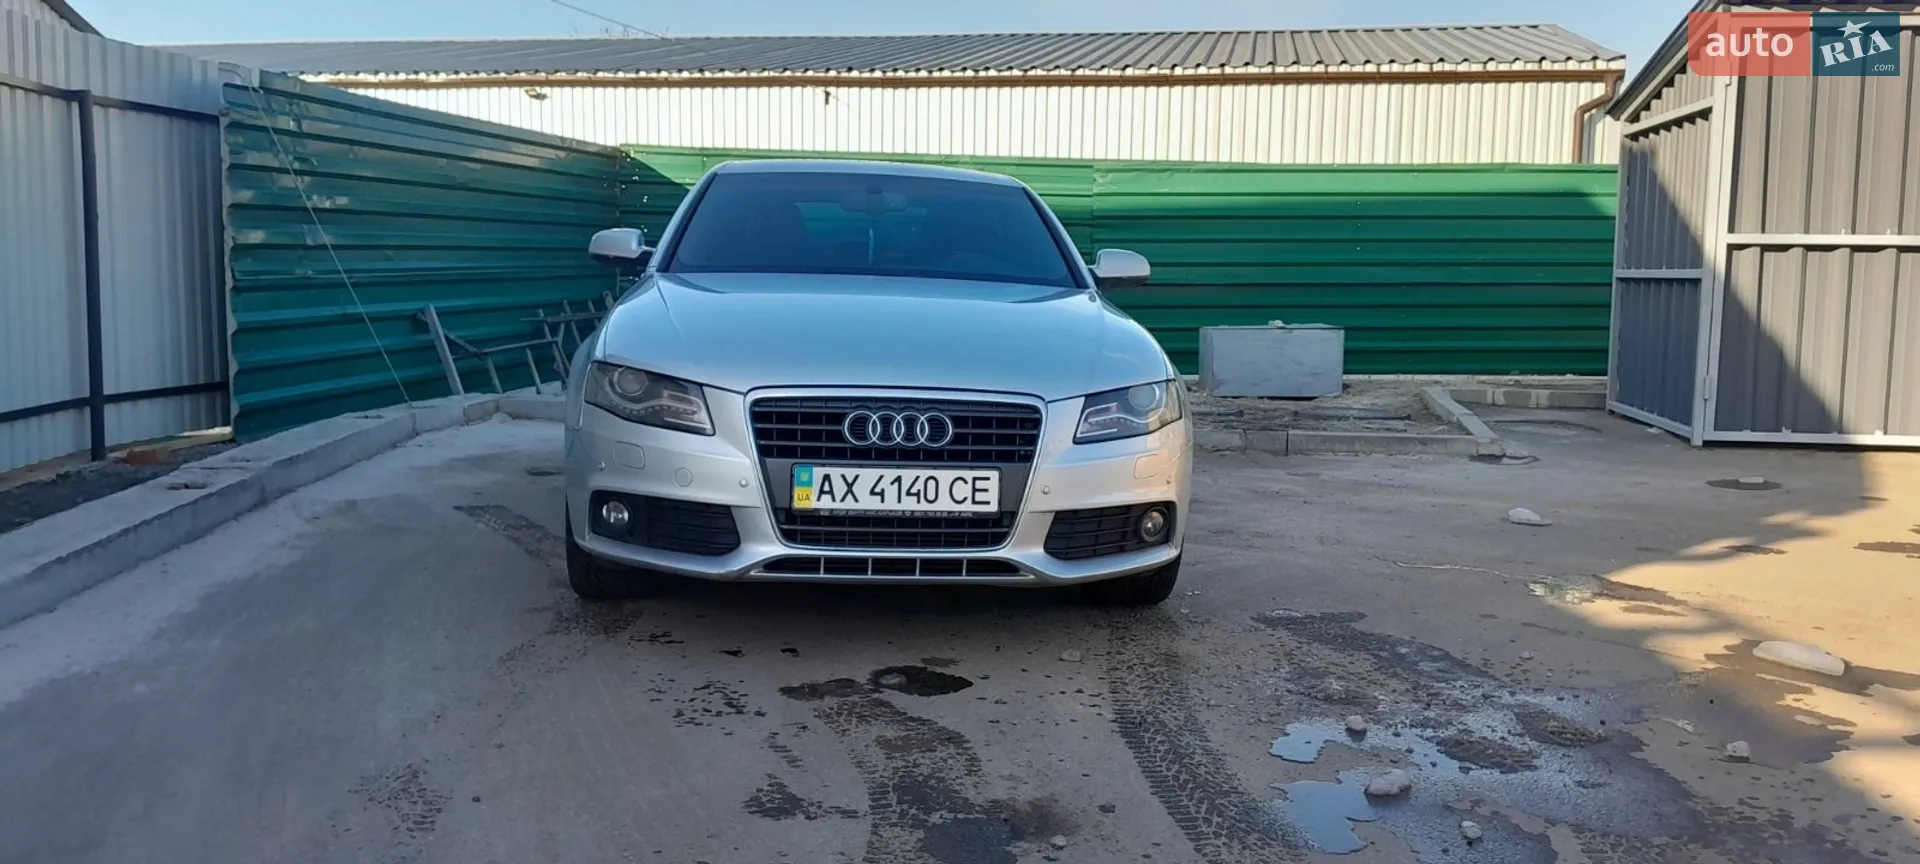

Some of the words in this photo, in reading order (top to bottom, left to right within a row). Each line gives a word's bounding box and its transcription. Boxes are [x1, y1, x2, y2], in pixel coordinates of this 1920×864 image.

[798, 494, 810, 502] UA
[816, 473, 860, 503] AX
[869, 474, 940, 504] 4140
[949, 476, 991, 505] CE
